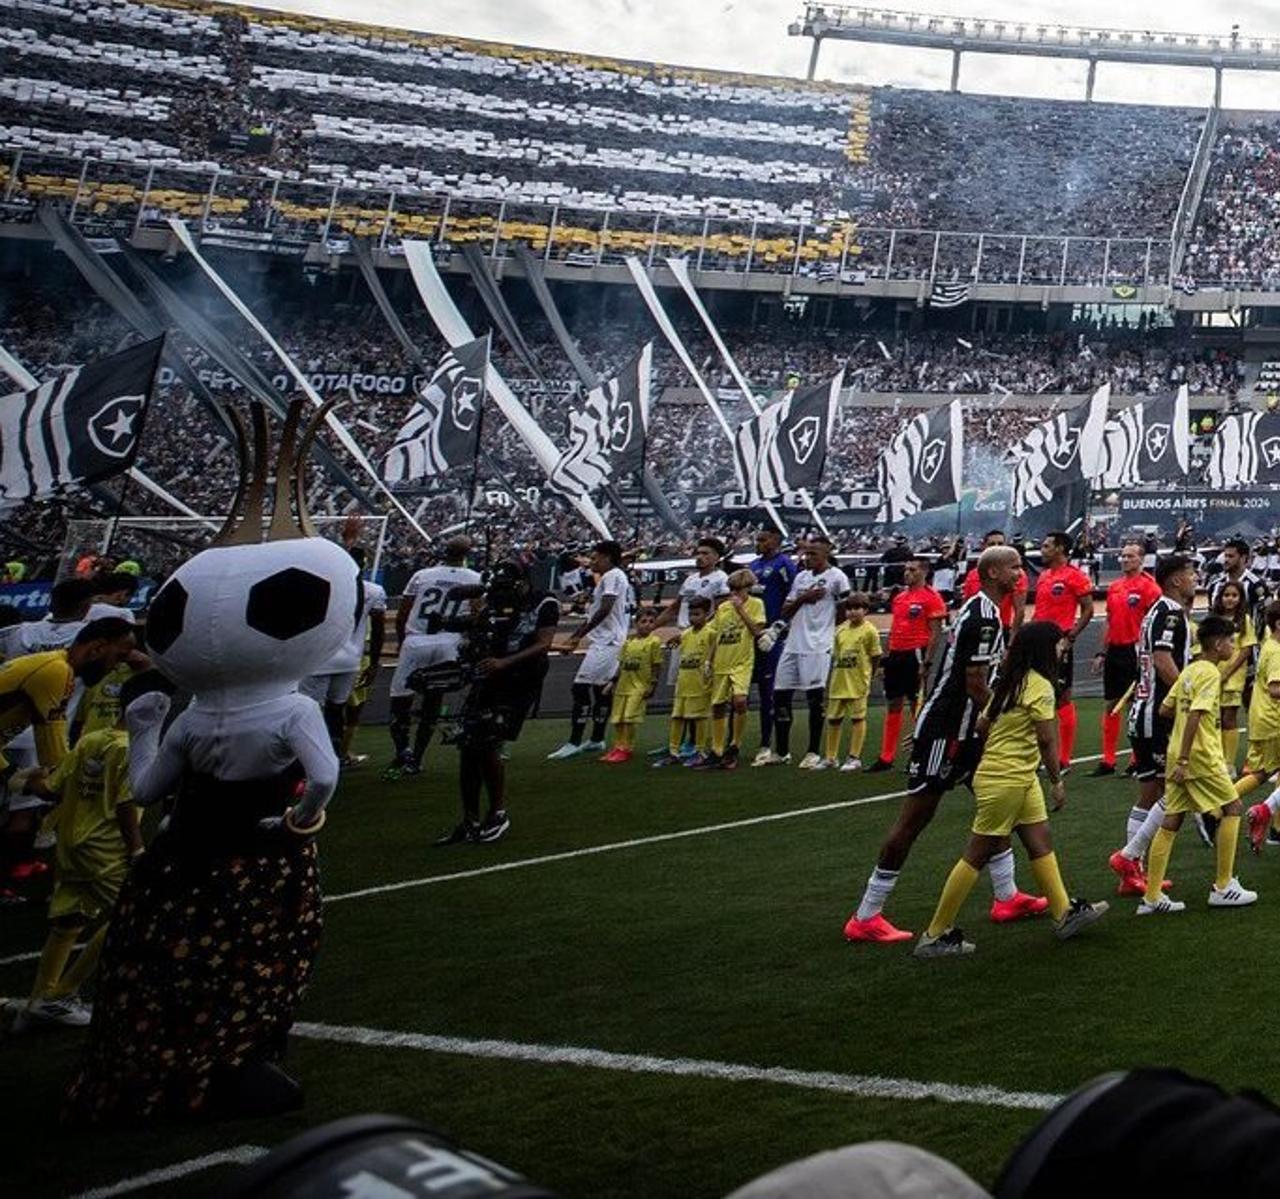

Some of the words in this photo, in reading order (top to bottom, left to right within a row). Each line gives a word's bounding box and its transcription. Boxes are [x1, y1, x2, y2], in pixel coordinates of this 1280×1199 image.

[1123, 499, 1171, 509] BUENOS
[1209, 498, 1242, 508] FINAL
[1243, 498, 1271, 508] 2024
